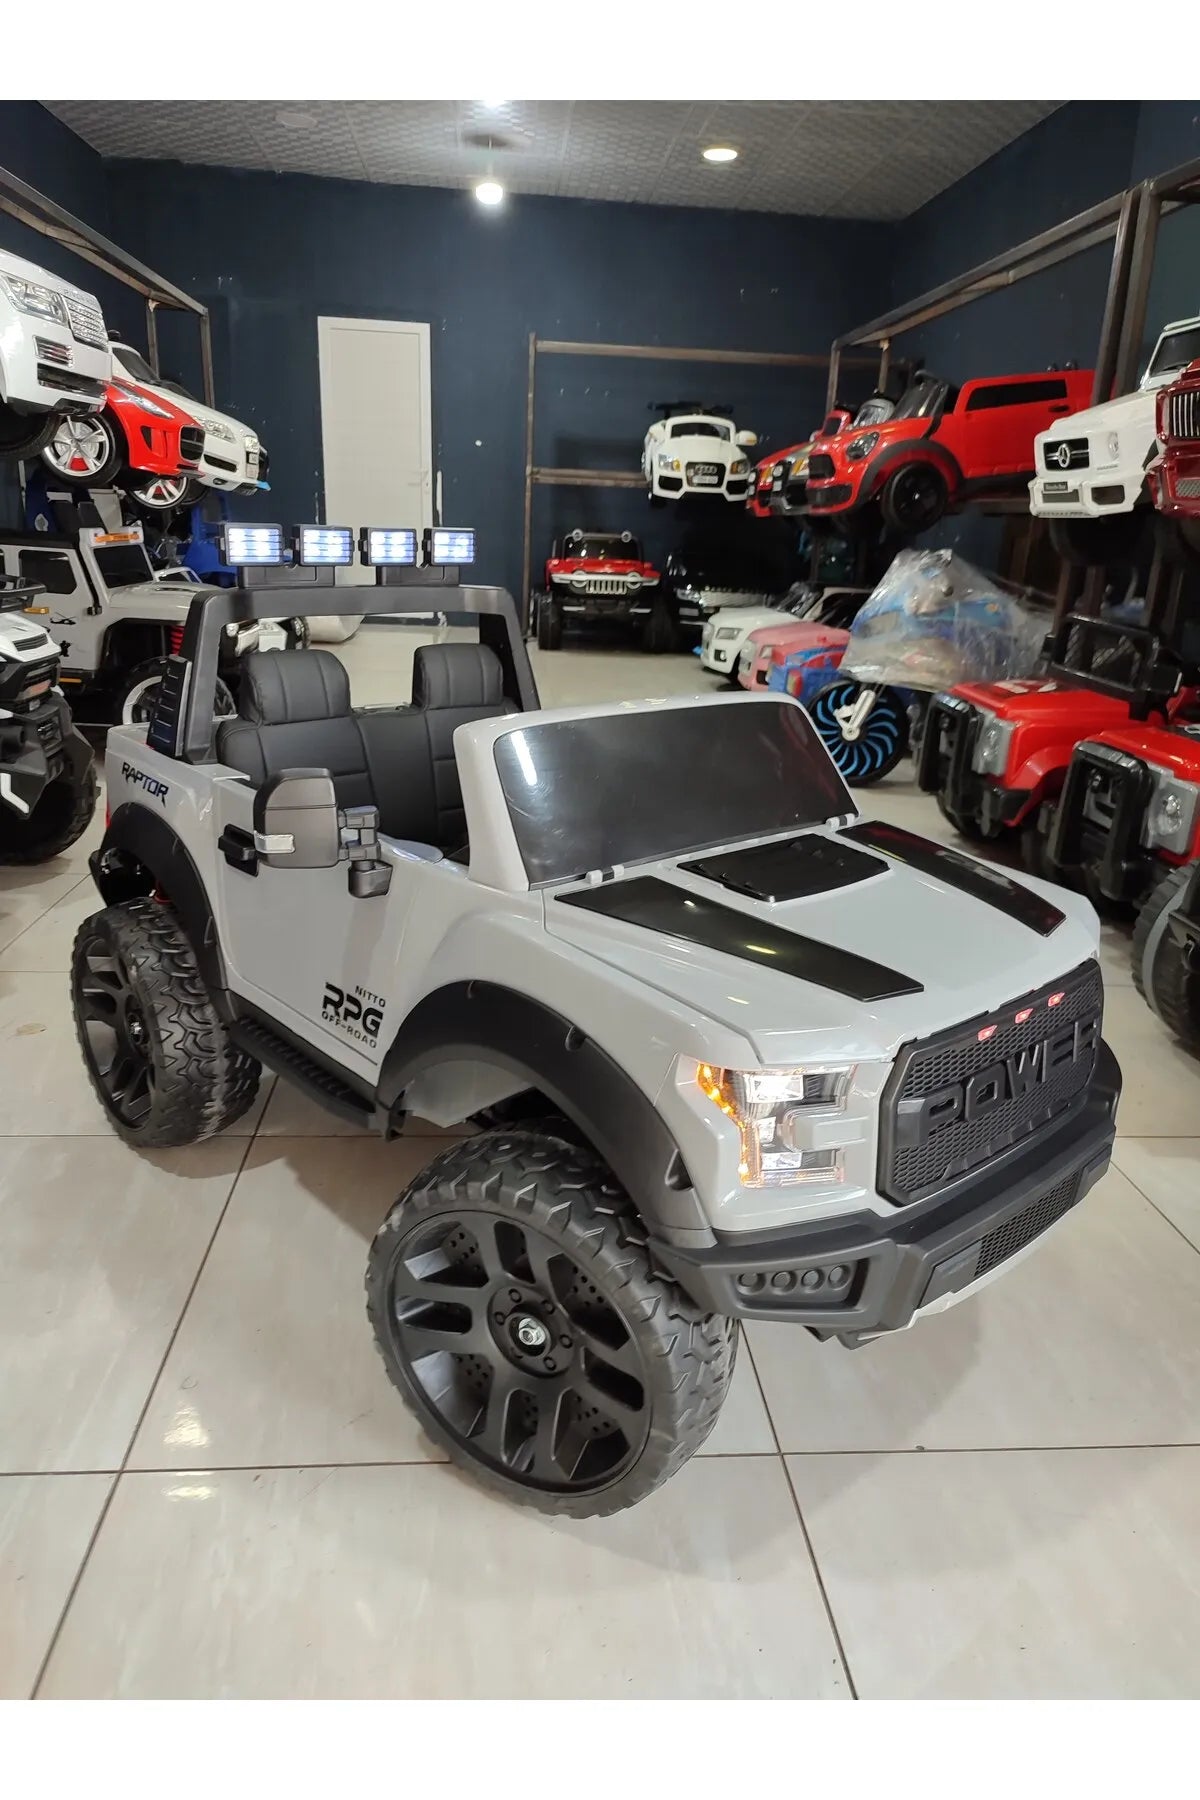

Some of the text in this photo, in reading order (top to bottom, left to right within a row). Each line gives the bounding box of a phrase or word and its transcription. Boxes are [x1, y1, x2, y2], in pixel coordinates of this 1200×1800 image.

[122, 761, 169, 808] RAPTOR
[322, 982, 383, 1038] RPG
[355, 985, 386, 1008] NITTO
[321, 1011, 377, 1049] OFF-ROAD
[899, 1015, 1100, 1147] POWER
